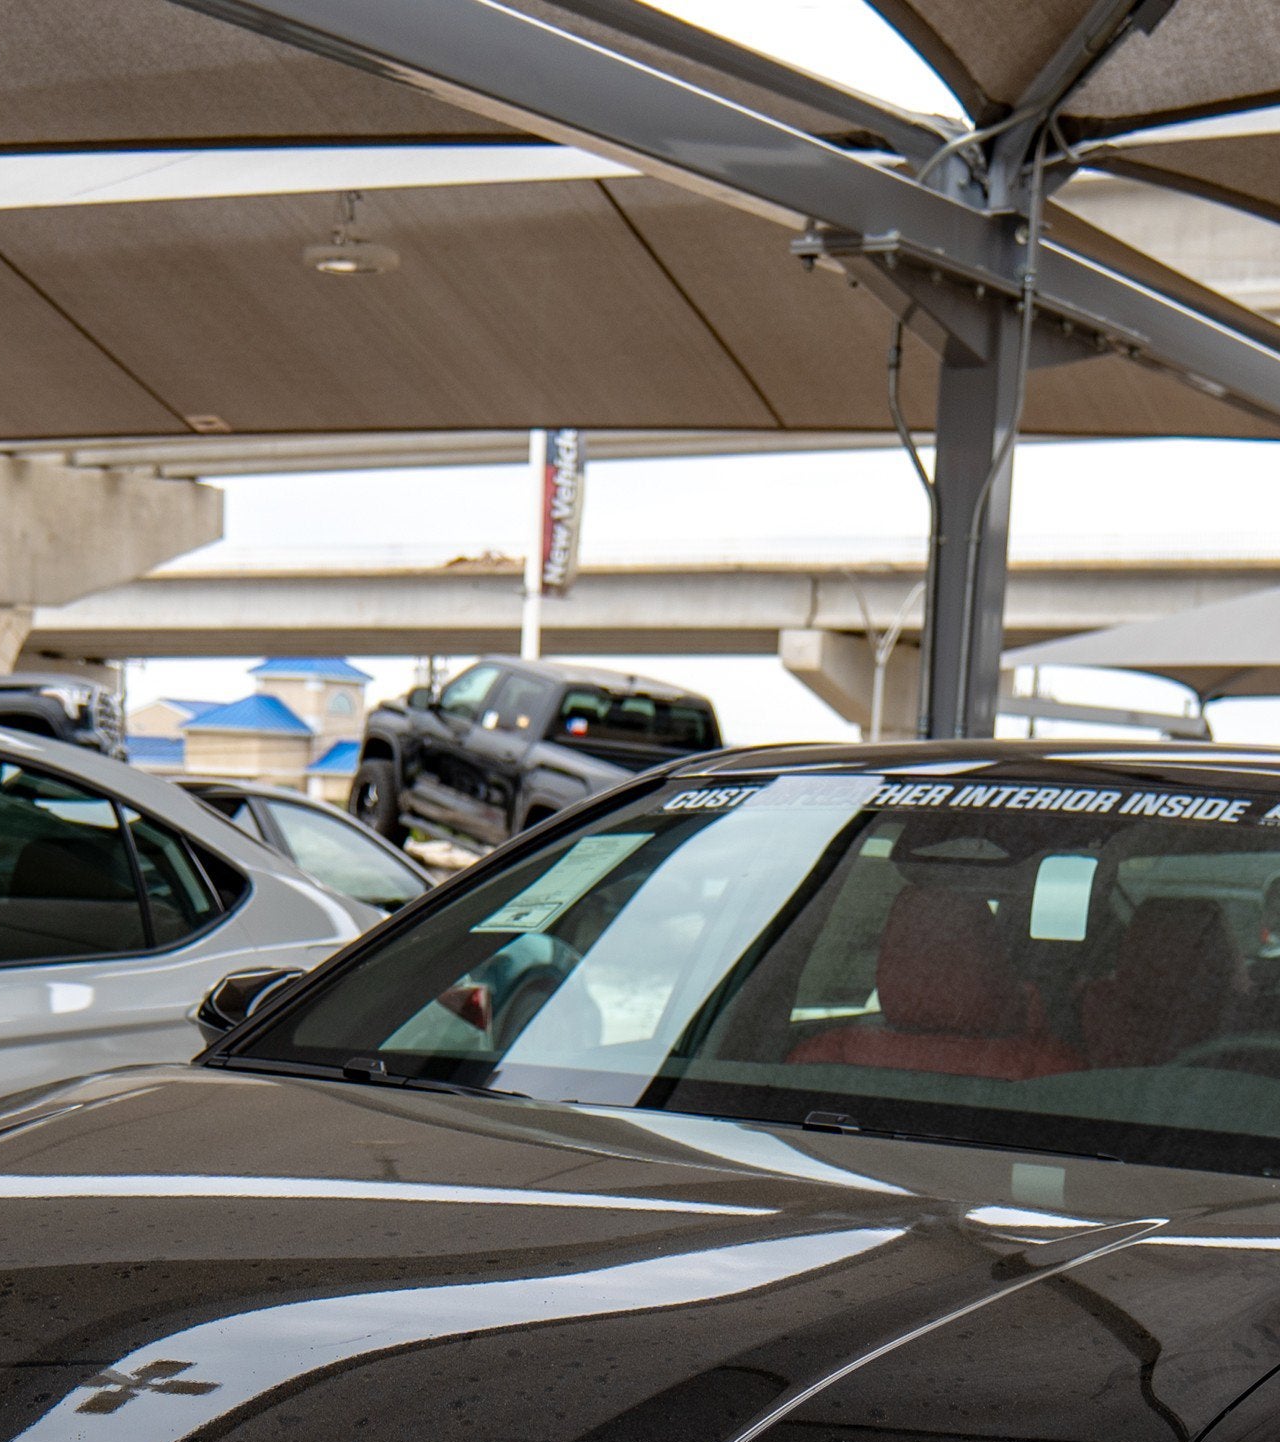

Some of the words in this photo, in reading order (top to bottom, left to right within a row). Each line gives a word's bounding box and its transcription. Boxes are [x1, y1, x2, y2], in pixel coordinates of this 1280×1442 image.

[543, 523, 571, 585] New
[663, 786, 760, 810] CUST
[863, 783, 954, 806] THER
[949, 784, 1121, 813] INTERIOR
[1118, 791, 1252, 823] INSIDE
